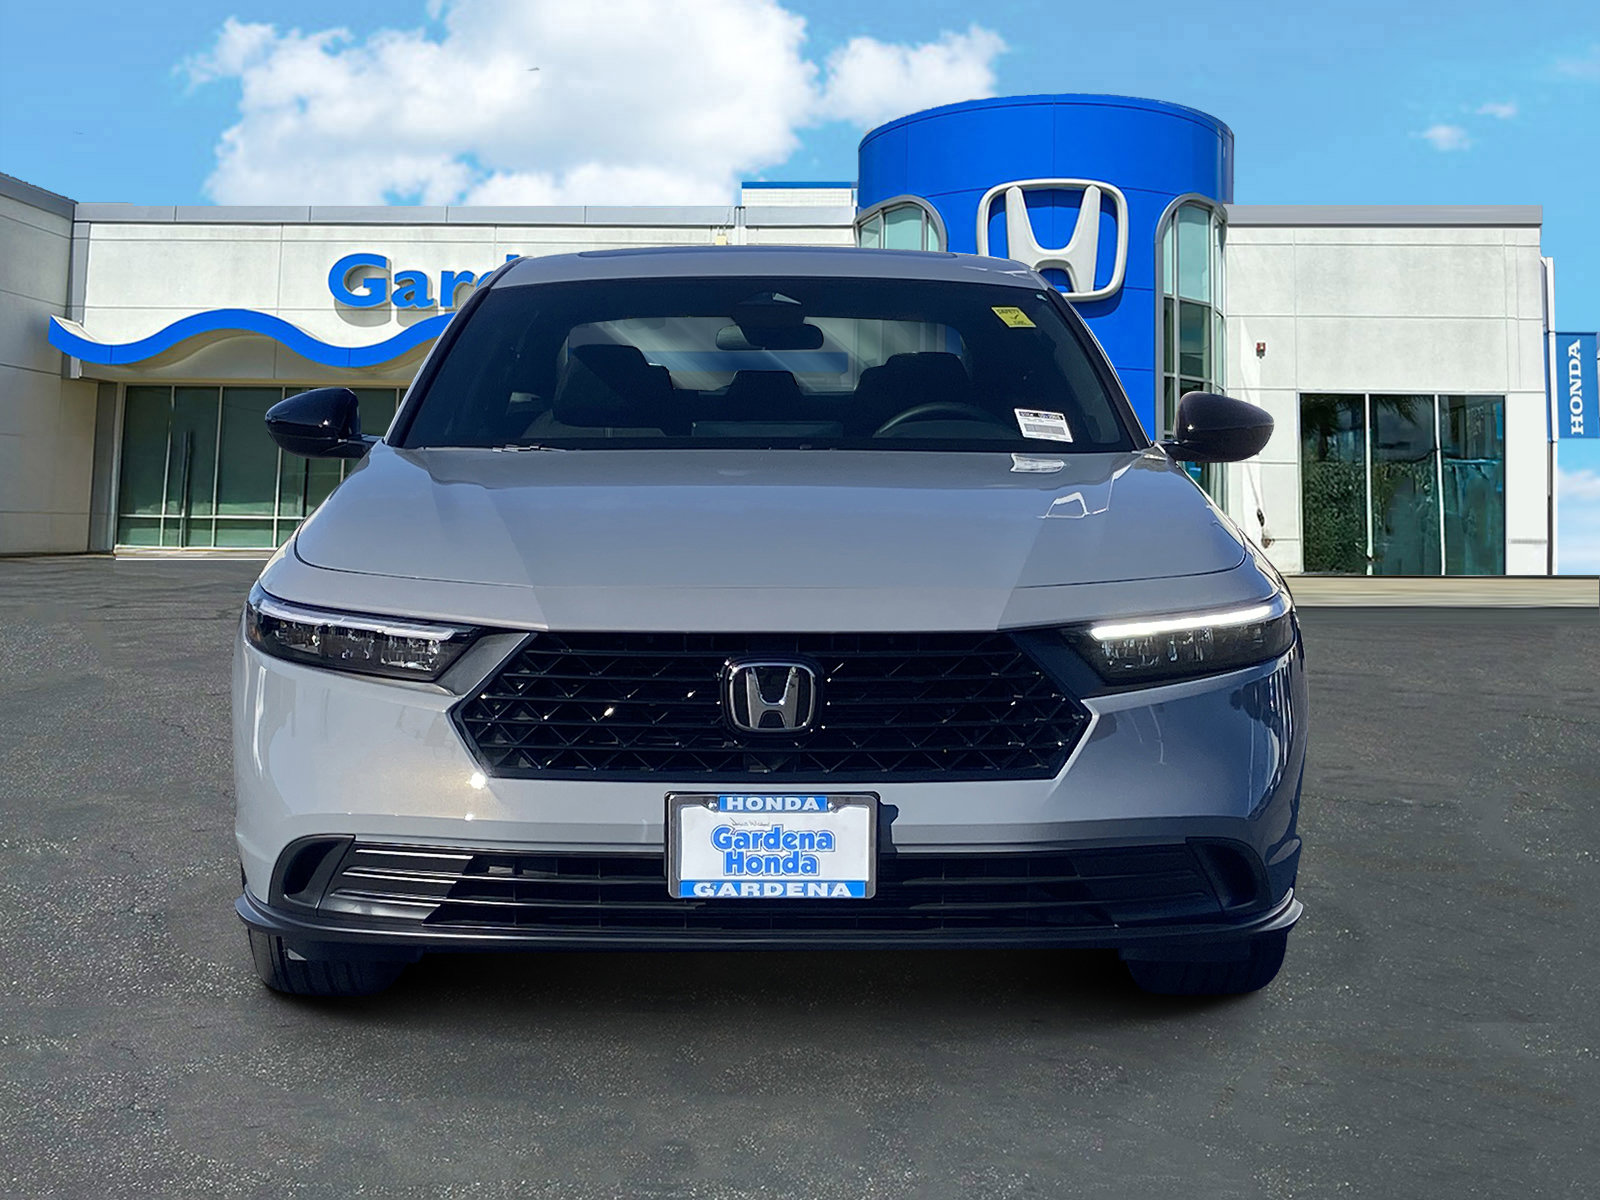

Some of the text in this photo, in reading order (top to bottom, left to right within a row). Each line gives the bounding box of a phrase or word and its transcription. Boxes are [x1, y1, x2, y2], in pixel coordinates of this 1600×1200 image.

[328, 252, 519, 308] Gar
[1568, 339, 1584, 434] HONDA
[726, 796, 820, 811] HONDA
[711, 825, 835, 852] Gardena
[724, 850, 819, 876] Honda
[693, 881, 852, 898] GARDENA
